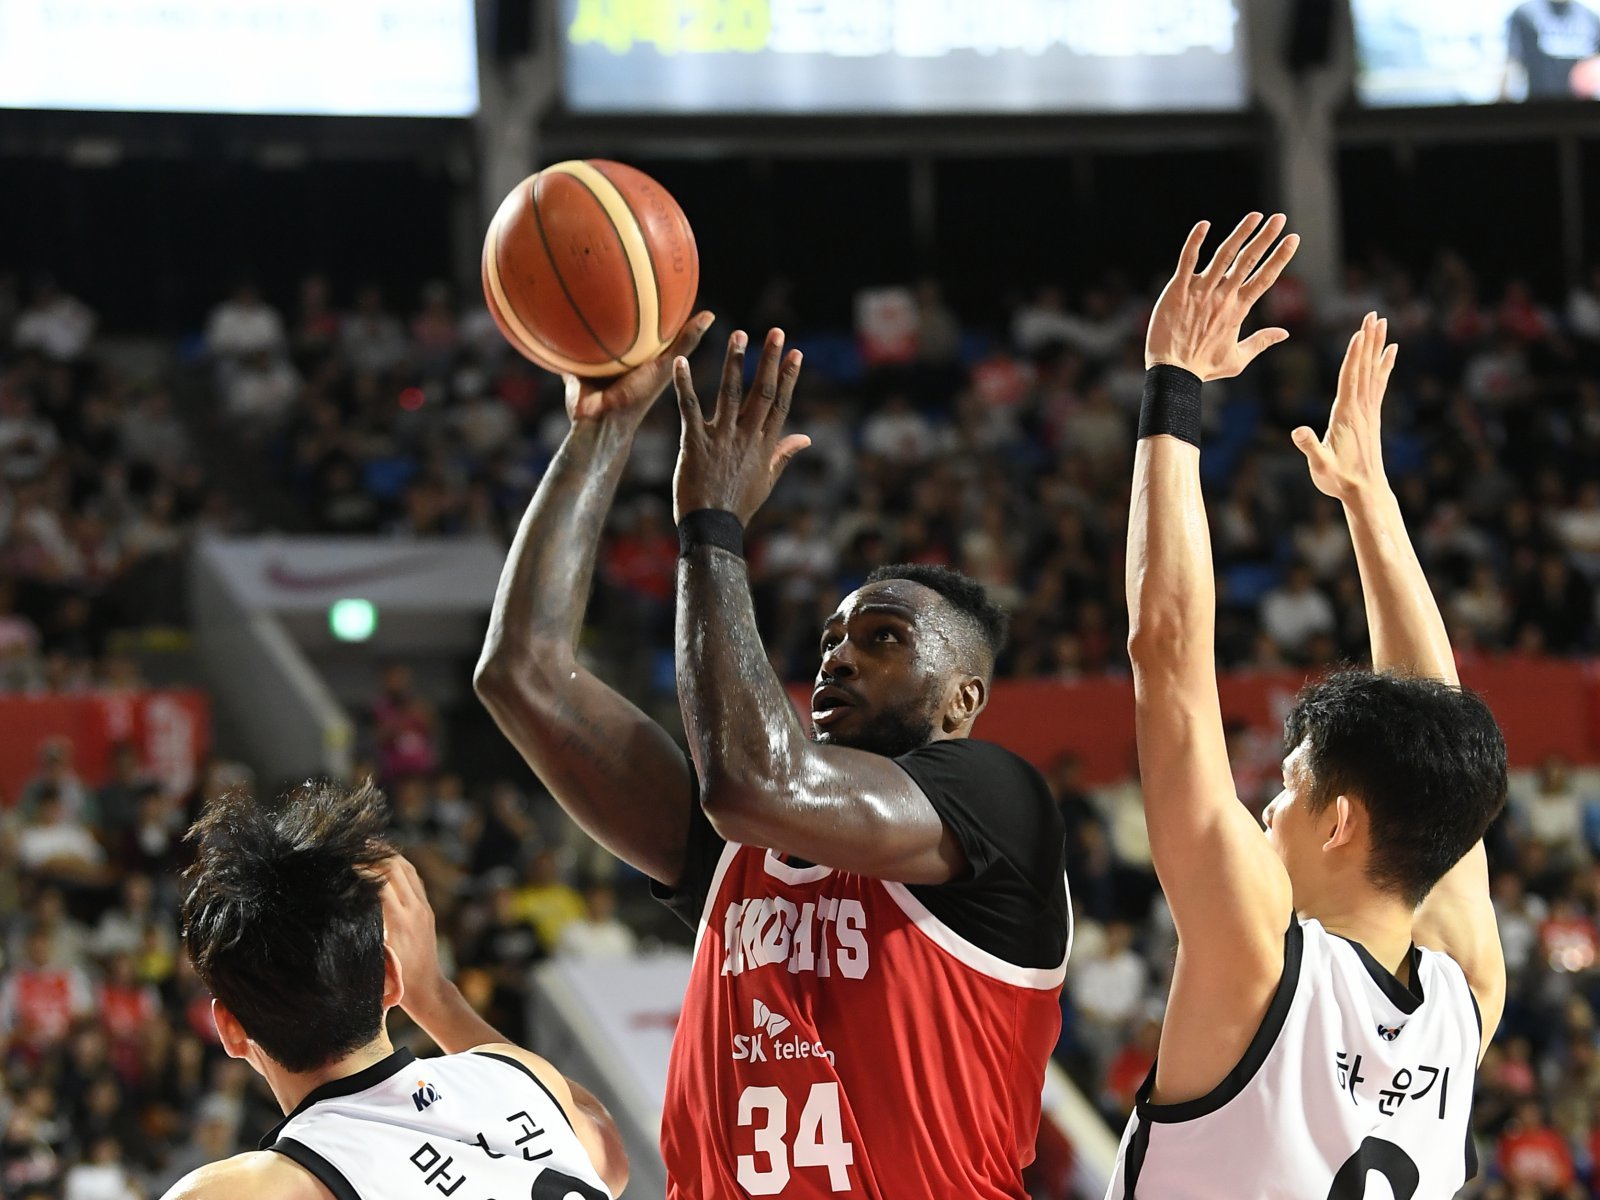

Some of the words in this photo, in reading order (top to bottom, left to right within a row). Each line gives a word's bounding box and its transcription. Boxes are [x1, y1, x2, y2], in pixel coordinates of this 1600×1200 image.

[733, 1033, 767, 1063] SK
[1336, 1051, 1450, 1120] 하윤기
[737, 1082, 853, 1196] 34
